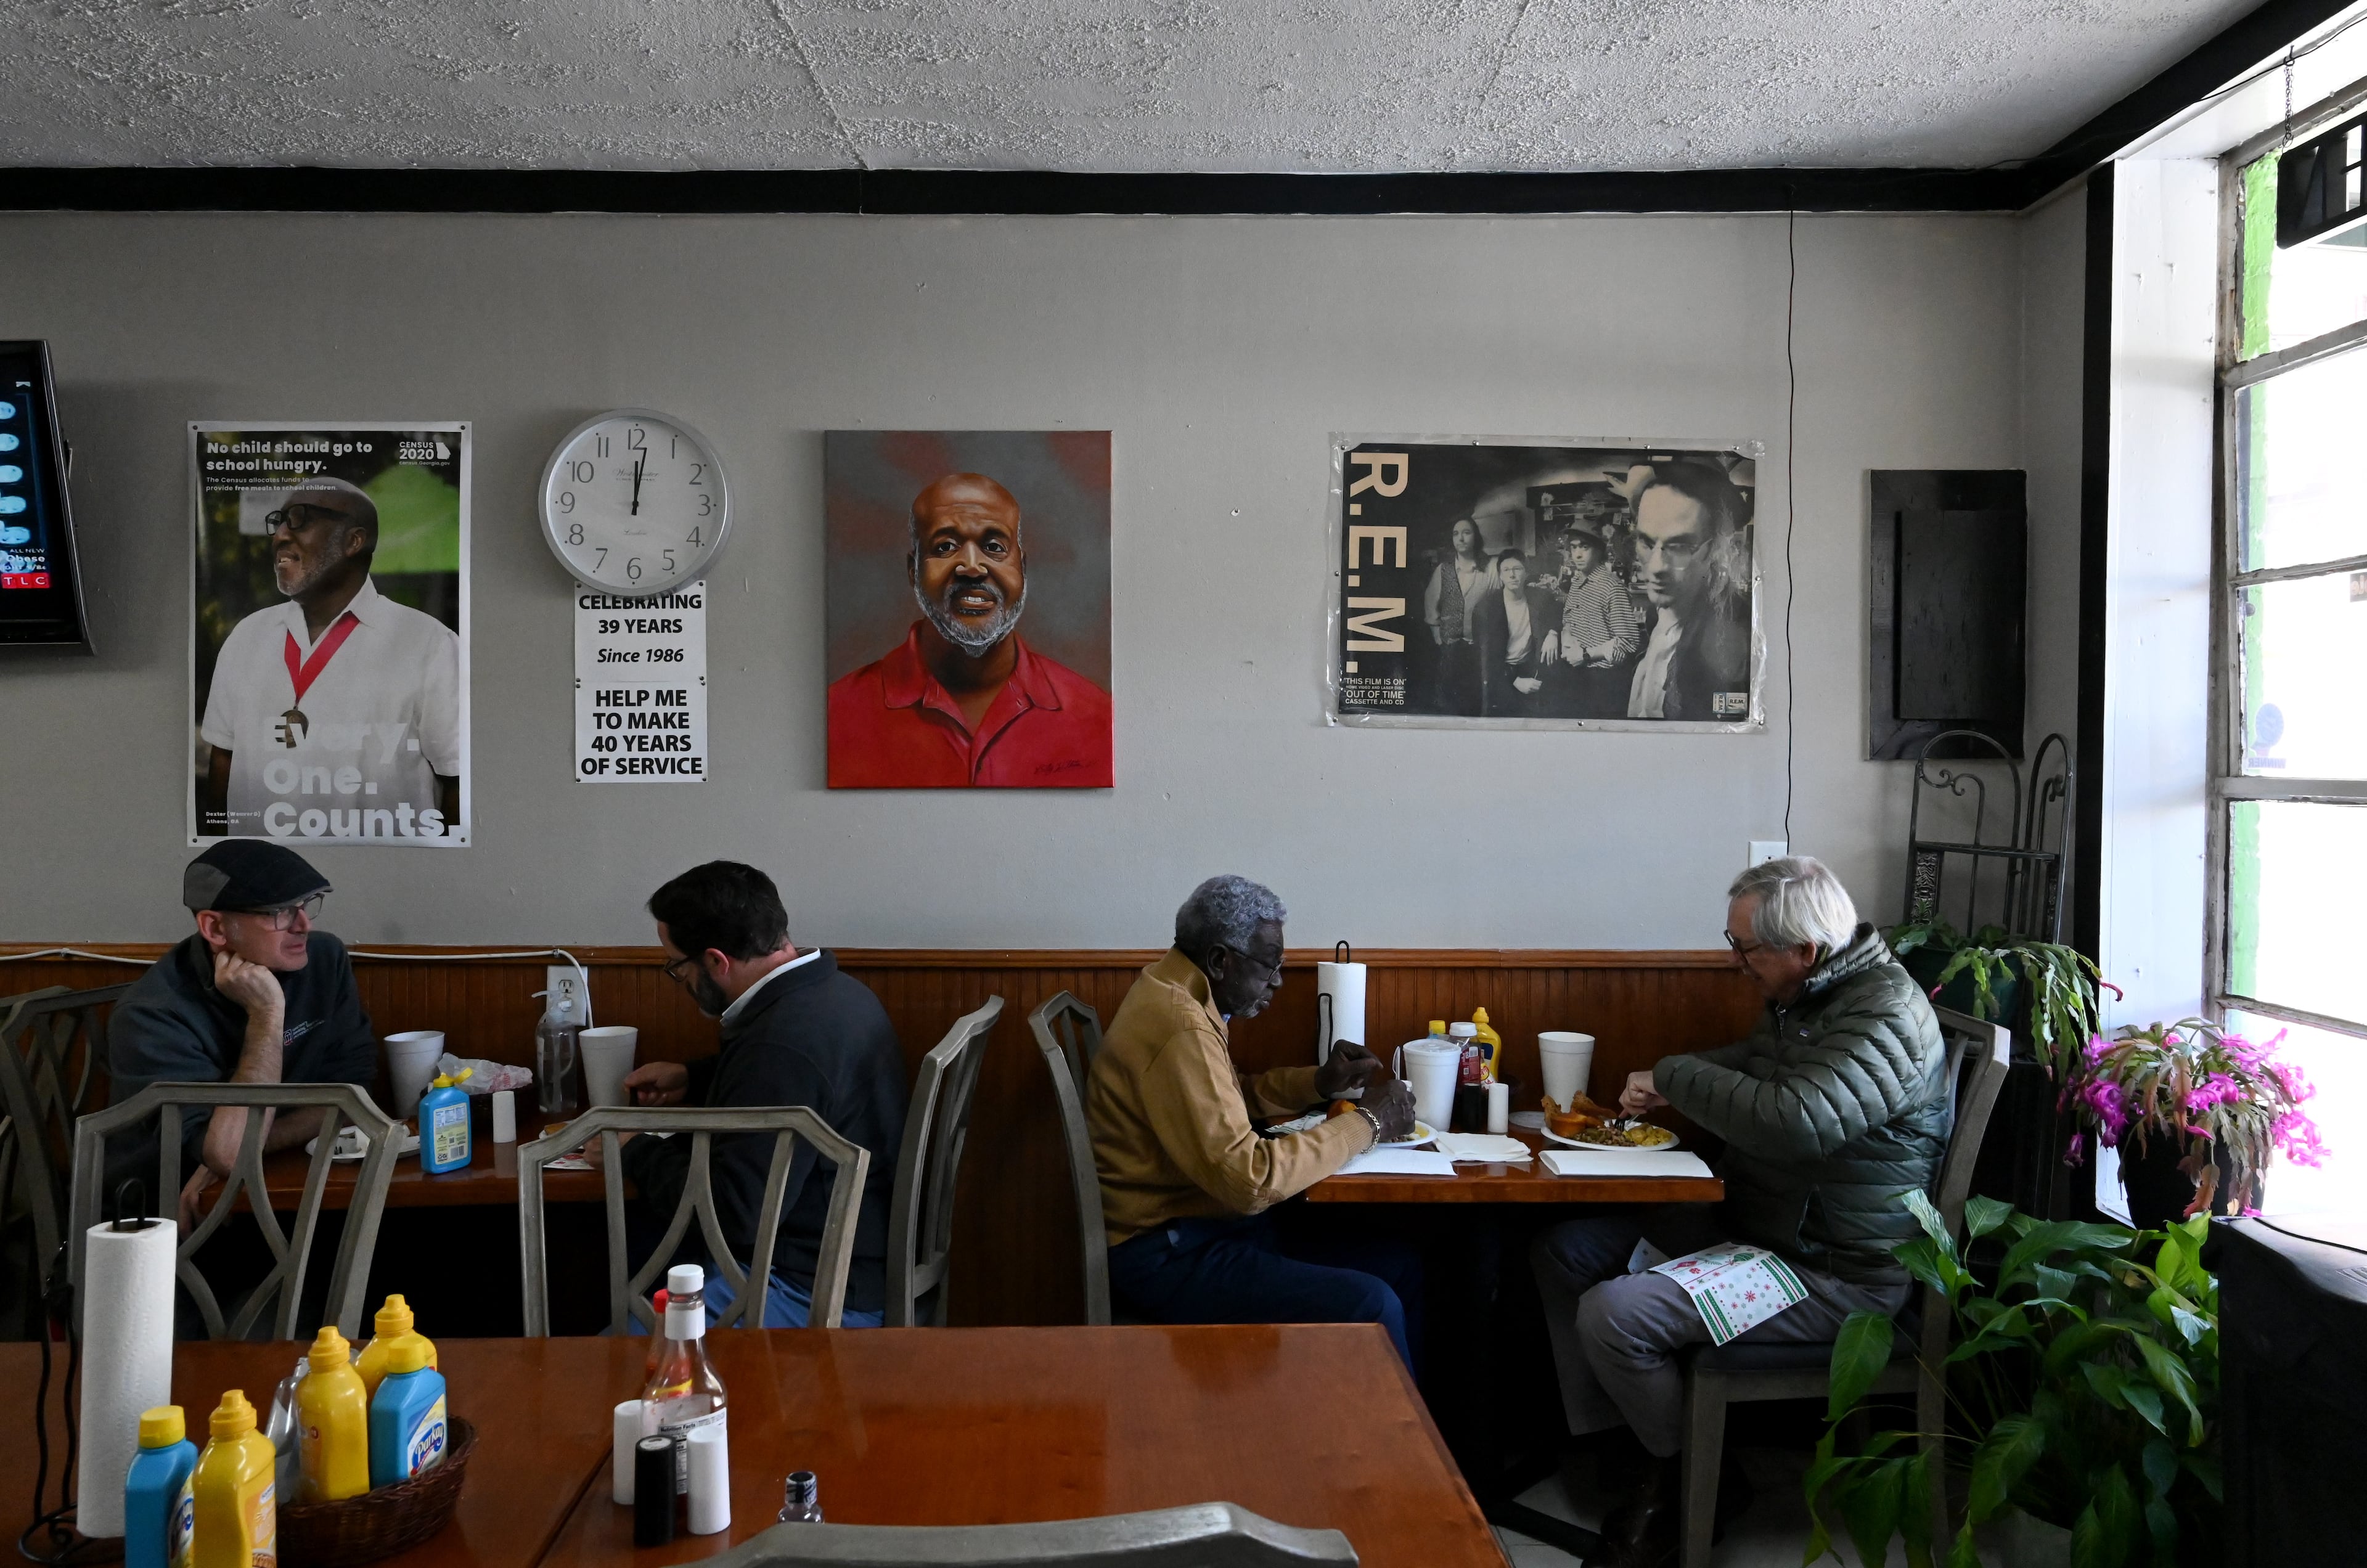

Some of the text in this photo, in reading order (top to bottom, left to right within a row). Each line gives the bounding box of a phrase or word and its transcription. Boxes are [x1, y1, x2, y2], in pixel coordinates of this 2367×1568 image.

[207, 440, 372, 457] No child should go to
[598, 437, 609, 458] 11
[628, 428, 647, 450] 12
[672, 438, 675, 459] 1
[399, 448, 434, 460] 2020
[206, 459, 327, 473] school hungry.
[572, 461, 594, 483] 10
[689, 463, 702, 485] 2
[560, 492, 575, 513] 9
[698, 494, 711, 516] 3
[569, 524, 584, 545] 8
[685, 526, 701, 547] 4
[595, 548, 608, 569] 7
[626, 557, 642, 579] 6
[662, 549, 674, 571] 5
[1346, 452, 1408, 673] R.E.M.
[4, 577, 46, 585] TLC
[579, 594, 701, 610] CELEBRATING
[599, 619, 682, 634] 39 YEARS
[598, 648, 684, 663] Since 1986
[596, 690, 687, 707] HELP ME
[1368, 690, 1380, 698] OF
[593, 712, 690, 730] TO MAKE
[591, 735, 691, 752] 40 YEARS
[263, 758, 377, 794] One.
[581, 757, 703, 775] OF SERVICE
[263, 802, 460, 837] Counts.
